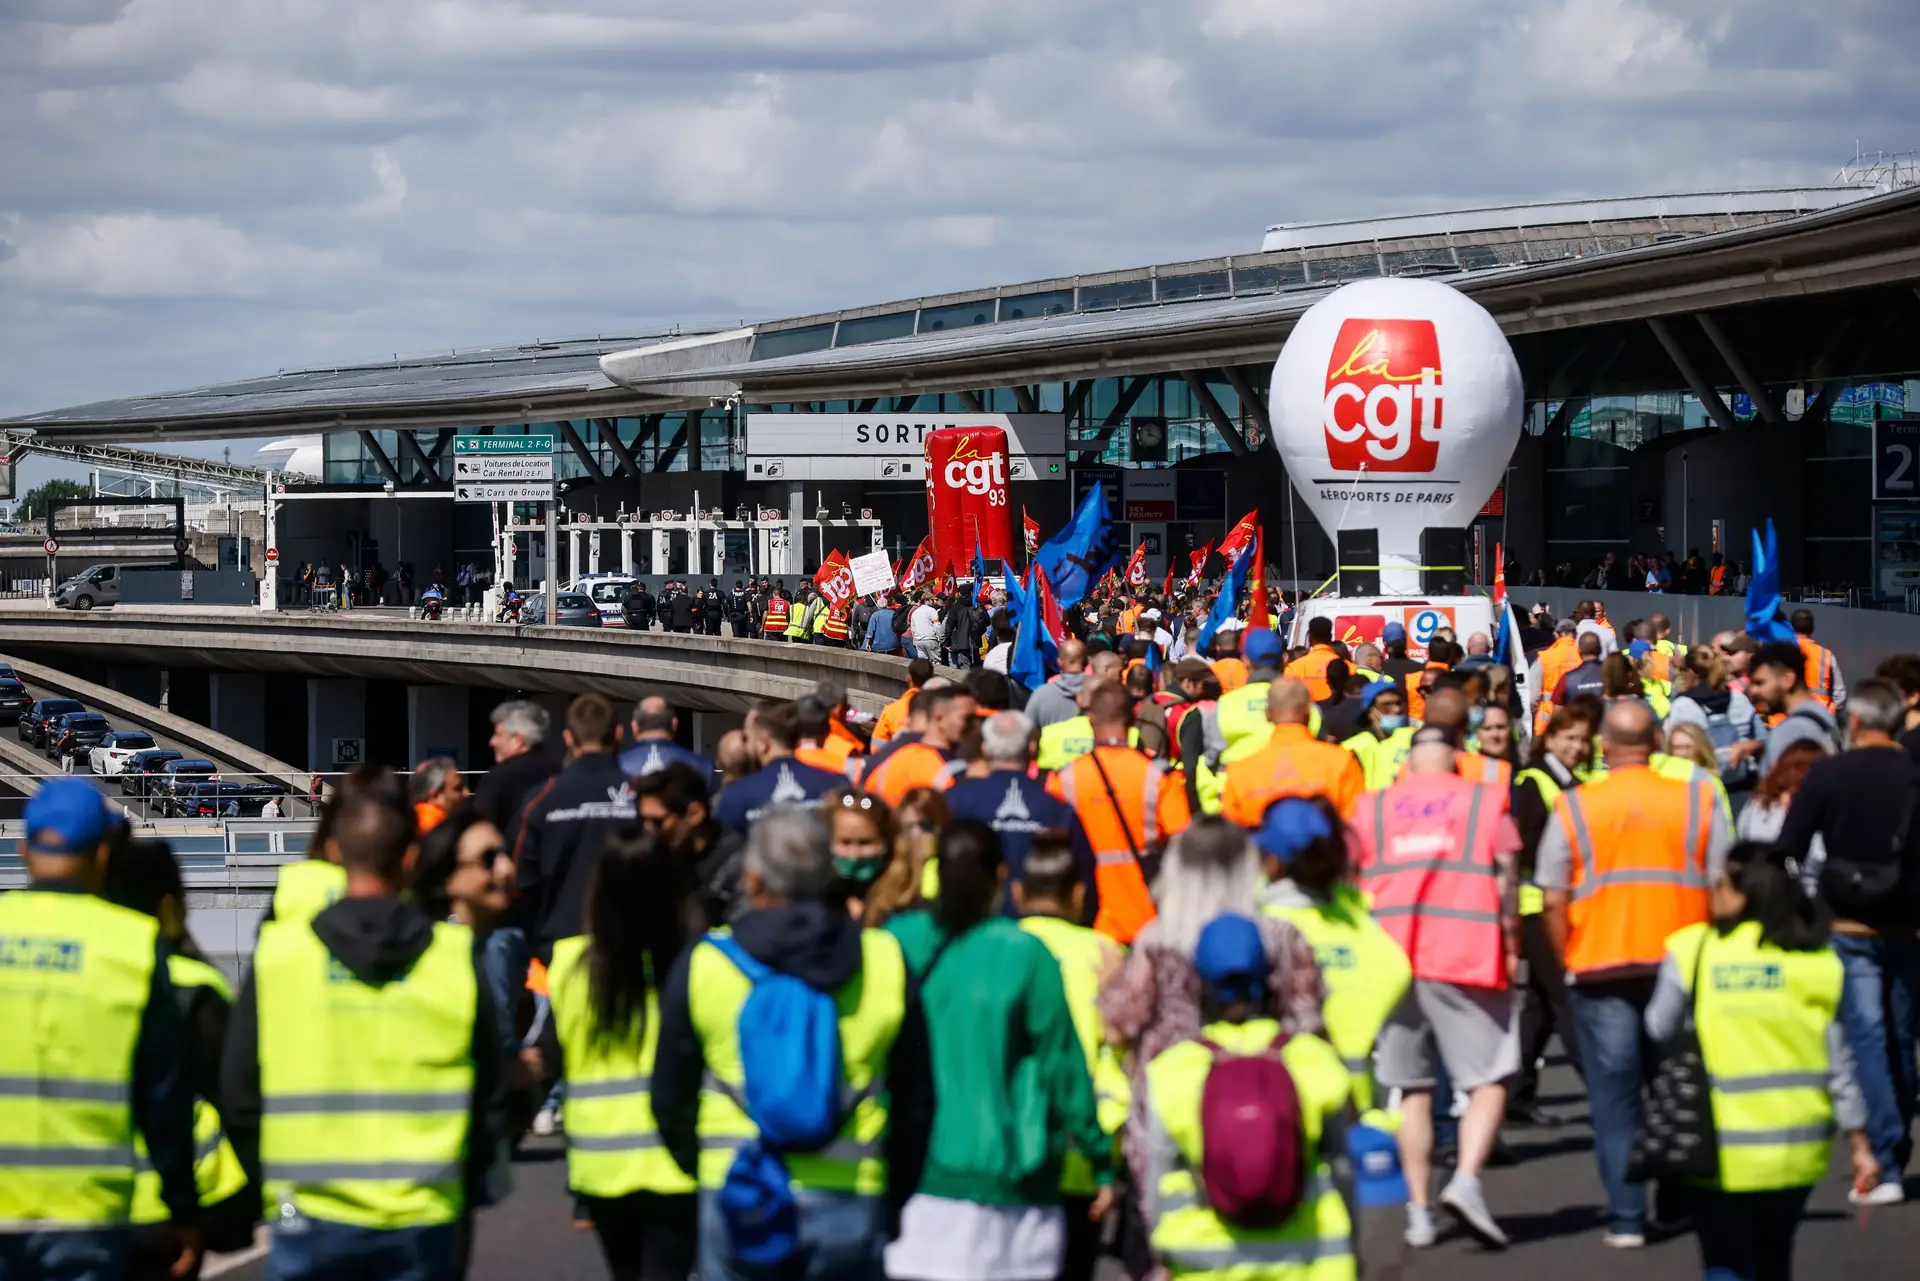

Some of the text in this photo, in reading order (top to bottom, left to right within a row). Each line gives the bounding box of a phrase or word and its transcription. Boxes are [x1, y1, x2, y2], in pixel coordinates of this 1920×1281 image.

[1330, 329, 1442, 381] la
[1323, 367, 1444, 461] cgt
[856, 424, 956, 444] SORT
[483, 440, 551, 449] TERMINAL 2 F-G
[947, 436, 1001, 462] la
[484, 460, 511, 468] Voitures
[945, 451, 1005, 495] cgt
[521, 489, 550, 499] Groupe
[989, 488, 1006, 507] 93
[1320, 488, 1454, 504] AÉROPORTS DE PARIS
[708, 592, 718, 600] 2A
